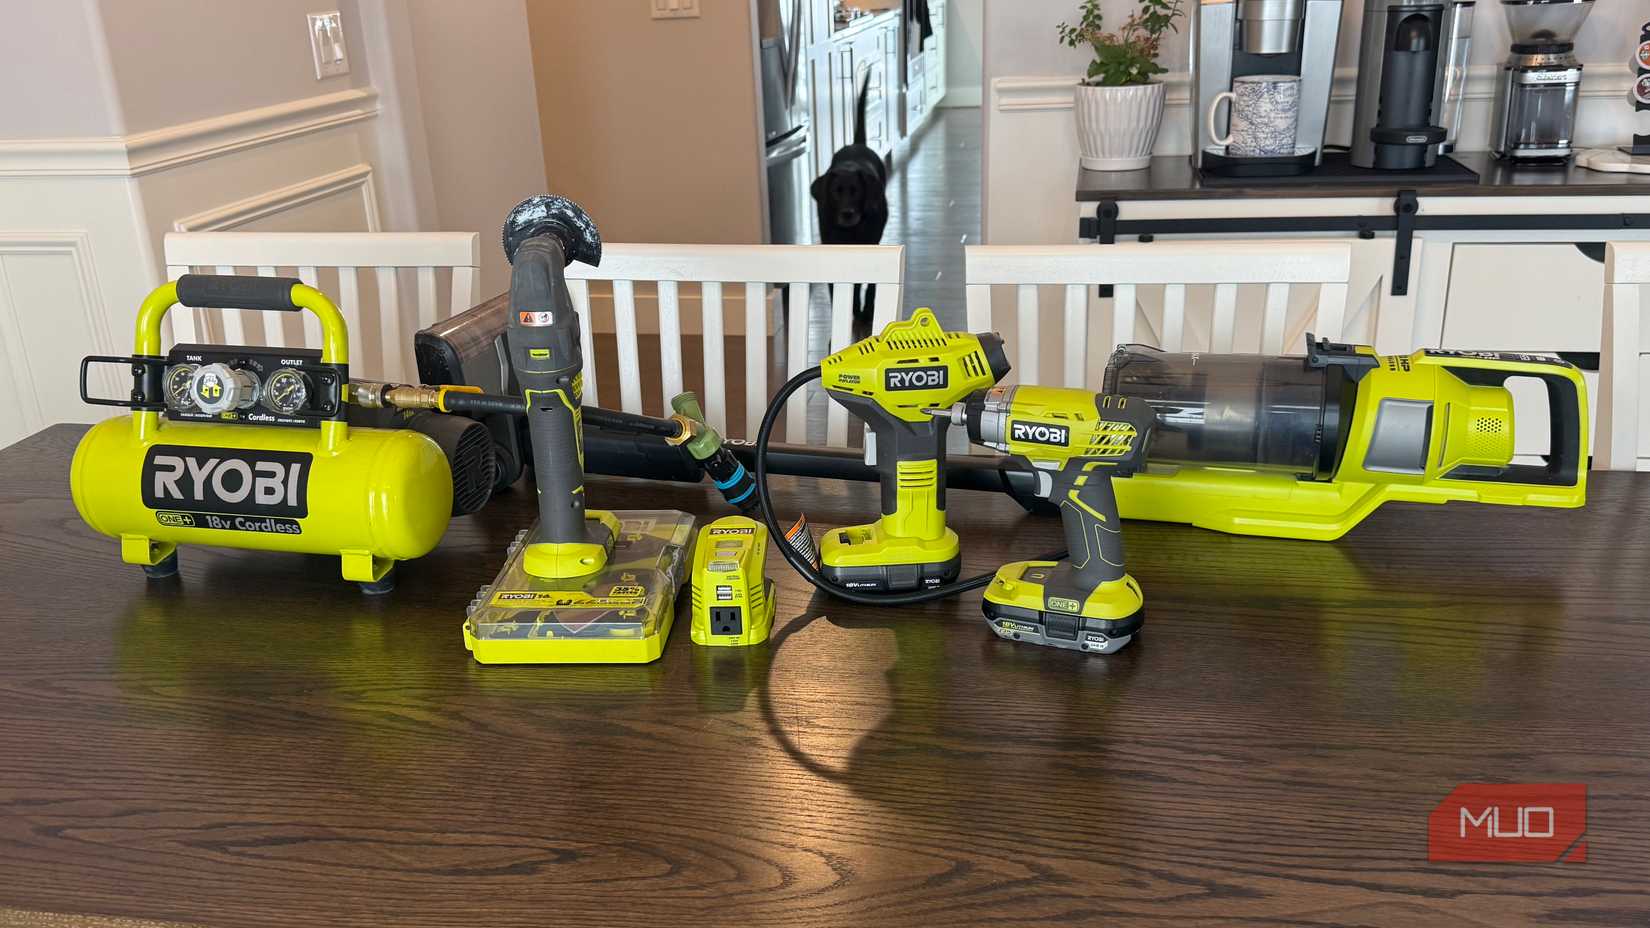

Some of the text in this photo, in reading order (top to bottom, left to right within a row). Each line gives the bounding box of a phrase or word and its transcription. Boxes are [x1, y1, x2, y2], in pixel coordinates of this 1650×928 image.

[888, 370, 945, 388] RYOBI
[248, 413, 276, 422] Cordless
[1012, 423, 1067, 443] RYOBI
[153, 455, 302, 507] RYOBI
[205, 515, 231, 529] 18v
[235, 518, 300, 534] Cordless
[1050, 600, 1076, 610] ONE+
